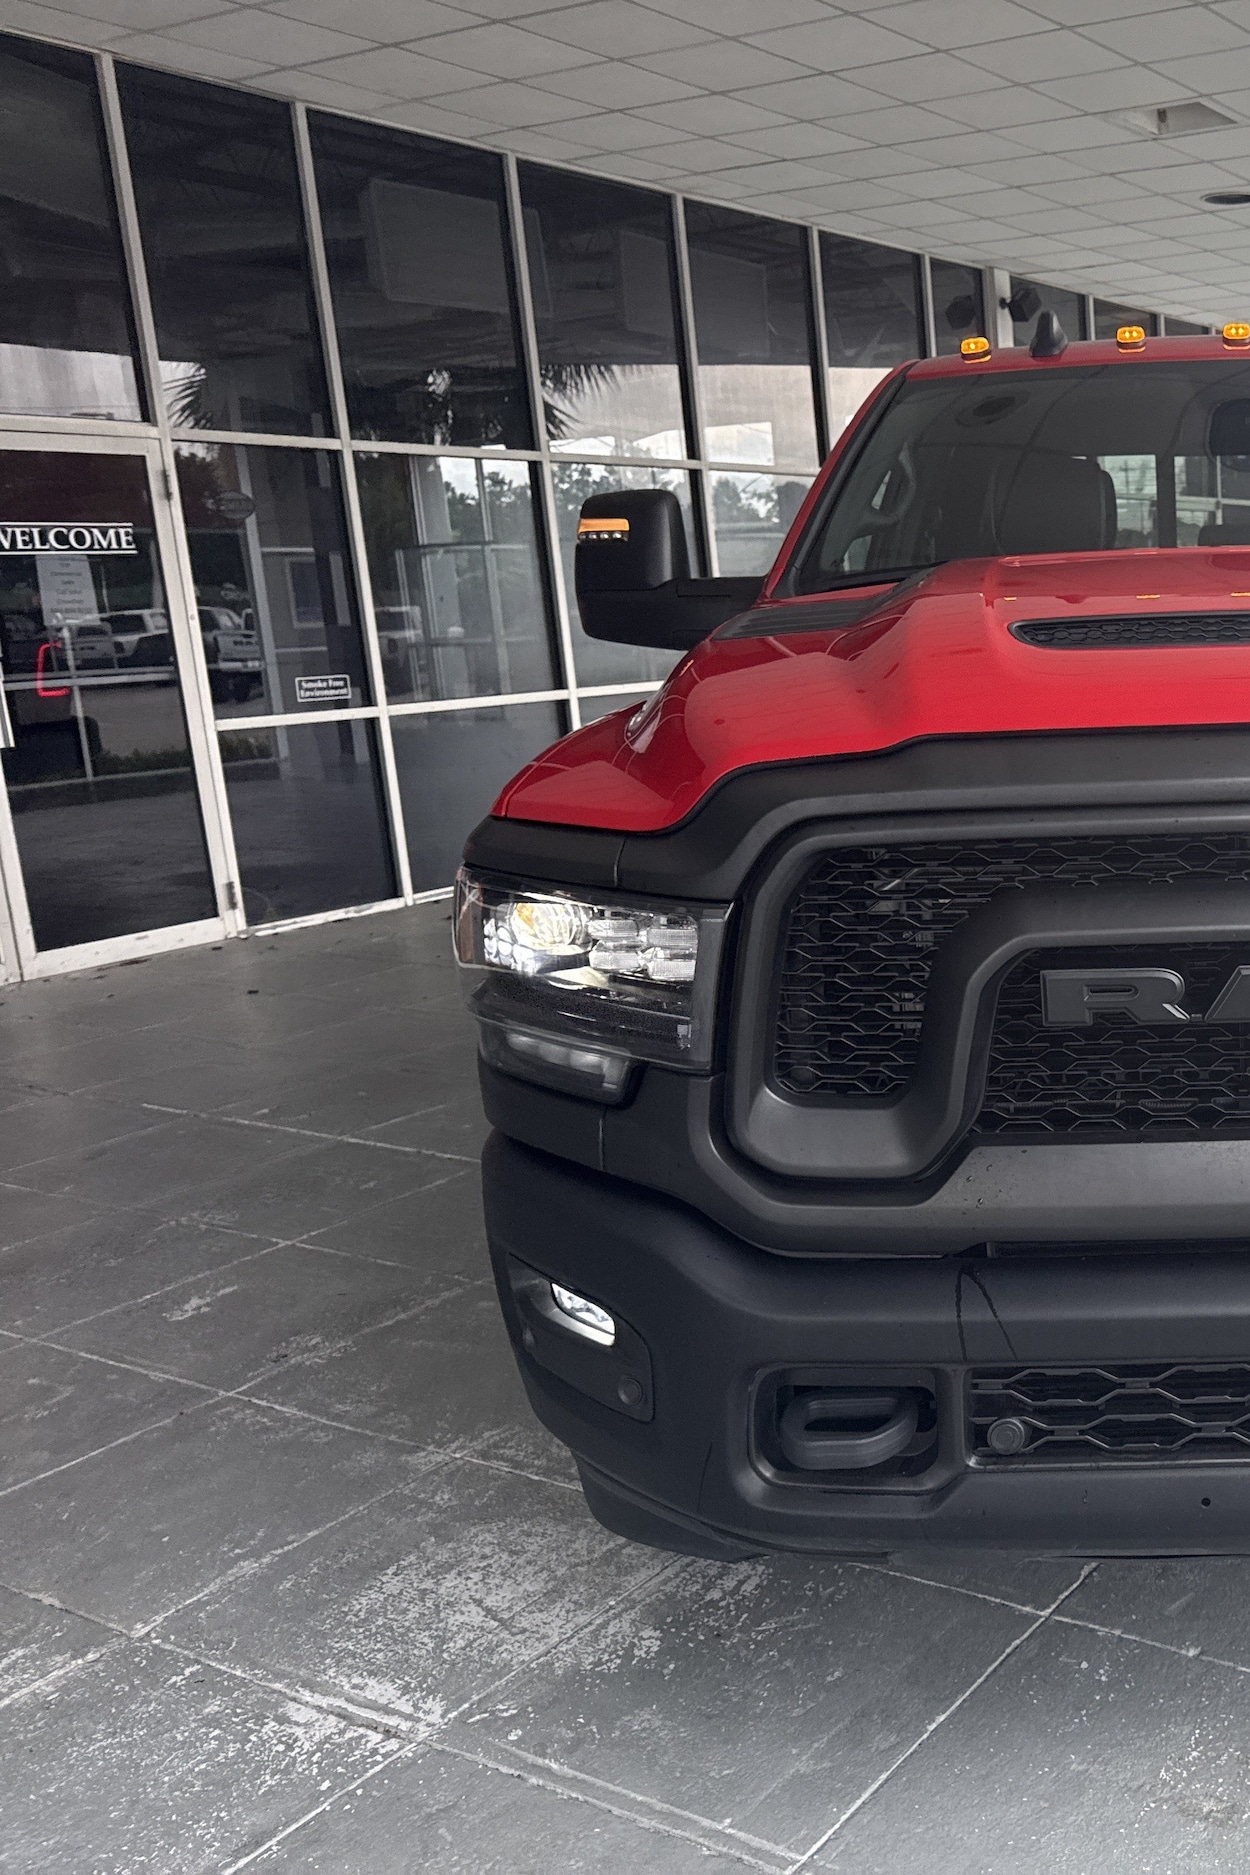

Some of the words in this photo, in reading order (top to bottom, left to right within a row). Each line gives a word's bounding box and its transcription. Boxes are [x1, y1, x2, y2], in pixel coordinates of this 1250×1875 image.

[301, 680, 327, 688] Smoke
[328, 678, 344, 687] Free
[300, 687, 347, 697] Environment
